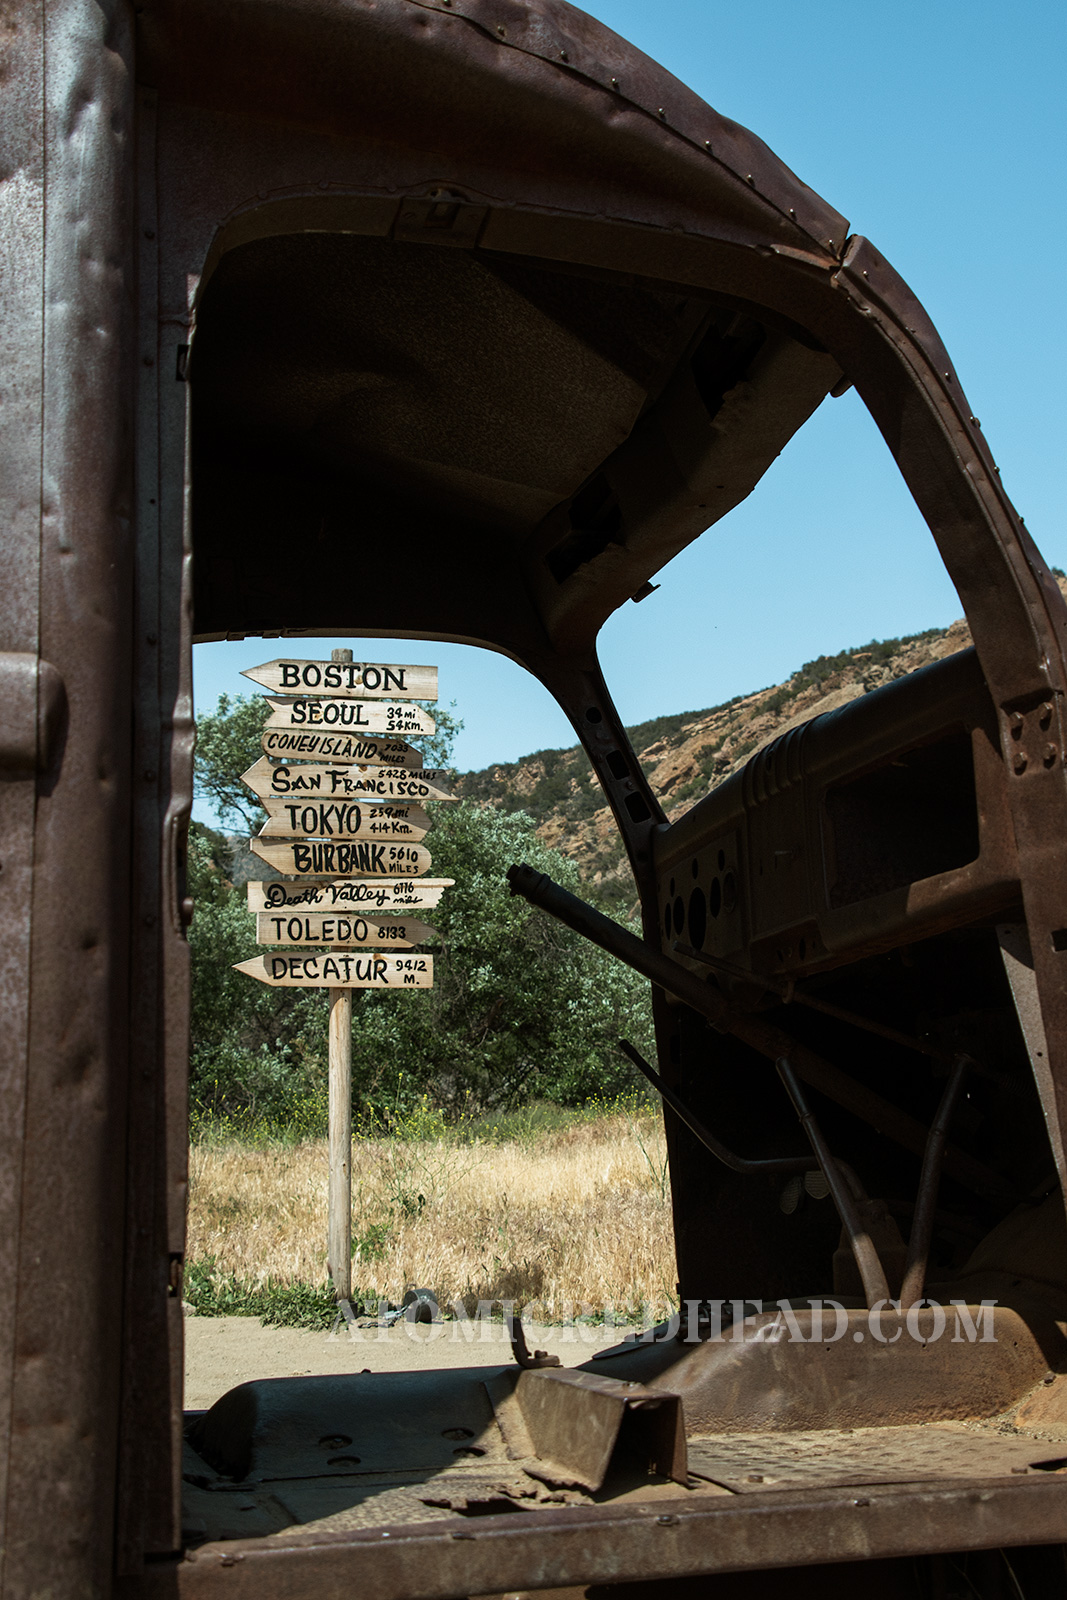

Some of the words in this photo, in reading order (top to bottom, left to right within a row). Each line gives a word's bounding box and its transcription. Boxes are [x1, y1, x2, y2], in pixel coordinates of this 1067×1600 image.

[279, 663, 408, 691] BOSTON
[291, 700, 369, 725] SEOUL
[387, 707, 403, 719] 34
[267, 733, 320, 754] CONEY
[318, 737, 377, 759] ISLAND
[380, 754, 406, 763] MILES
[384, 743, 409, 753] 7033
[271, 766, 321, 793] SAN
[325, 770, 430, 797] FRANCISCO
[378, 769, 407, 780] 5428
[284, 803, 362, 836] TOKYO
[291, 843, 387, 874] BURBANK
[389, 846, 419, 863] 5610
[264, 883, 323, 910] Death
[325, 884, 391, 906] Valley
[271, 917, 369, 942] TOLEDO
[271, 957, 389, 984] DECATUR
[396, 959, 428, 972] 9412
